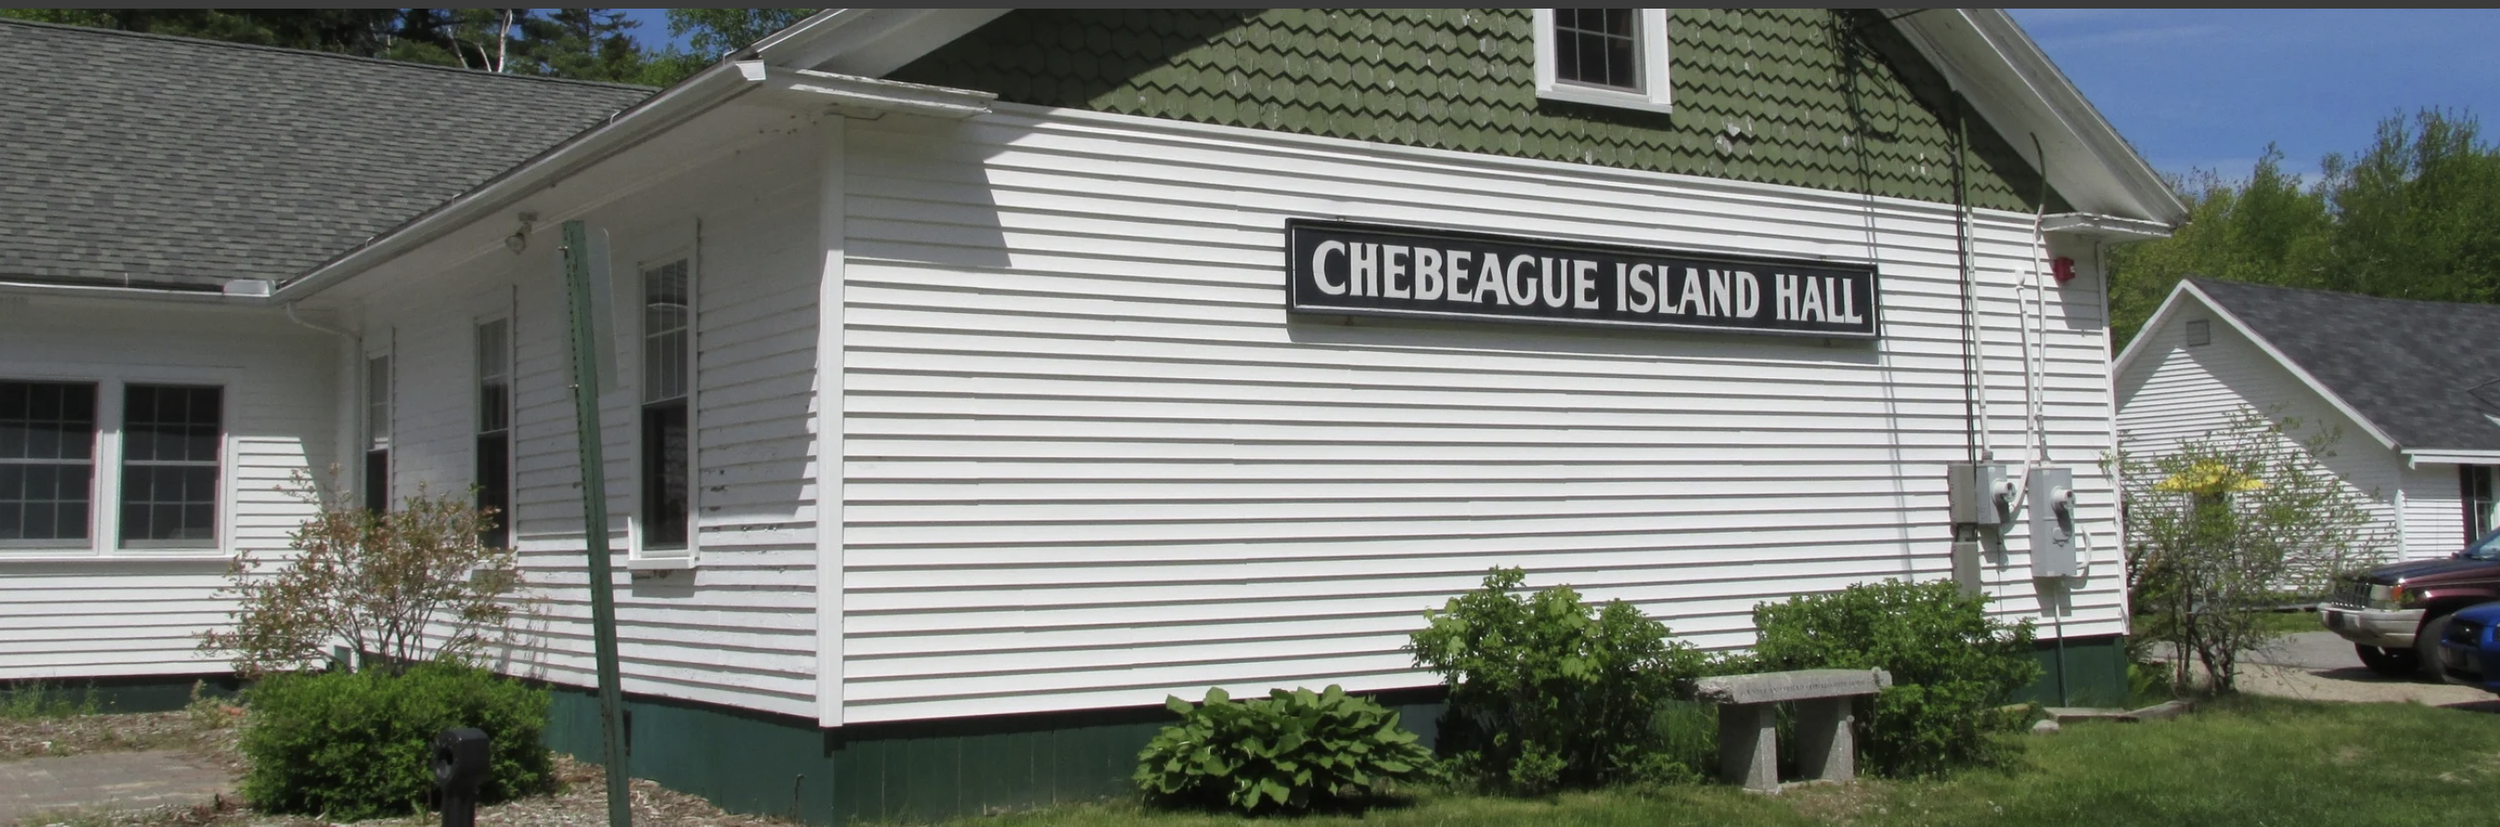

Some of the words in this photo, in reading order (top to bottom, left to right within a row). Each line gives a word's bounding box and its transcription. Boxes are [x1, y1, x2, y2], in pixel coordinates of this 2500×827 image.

[1312, 240, 1599, 310] CHEBEAGUE
[1616, 262, 1760, 319] ISLAND
[1775, 273, 1863, 324] HALL
